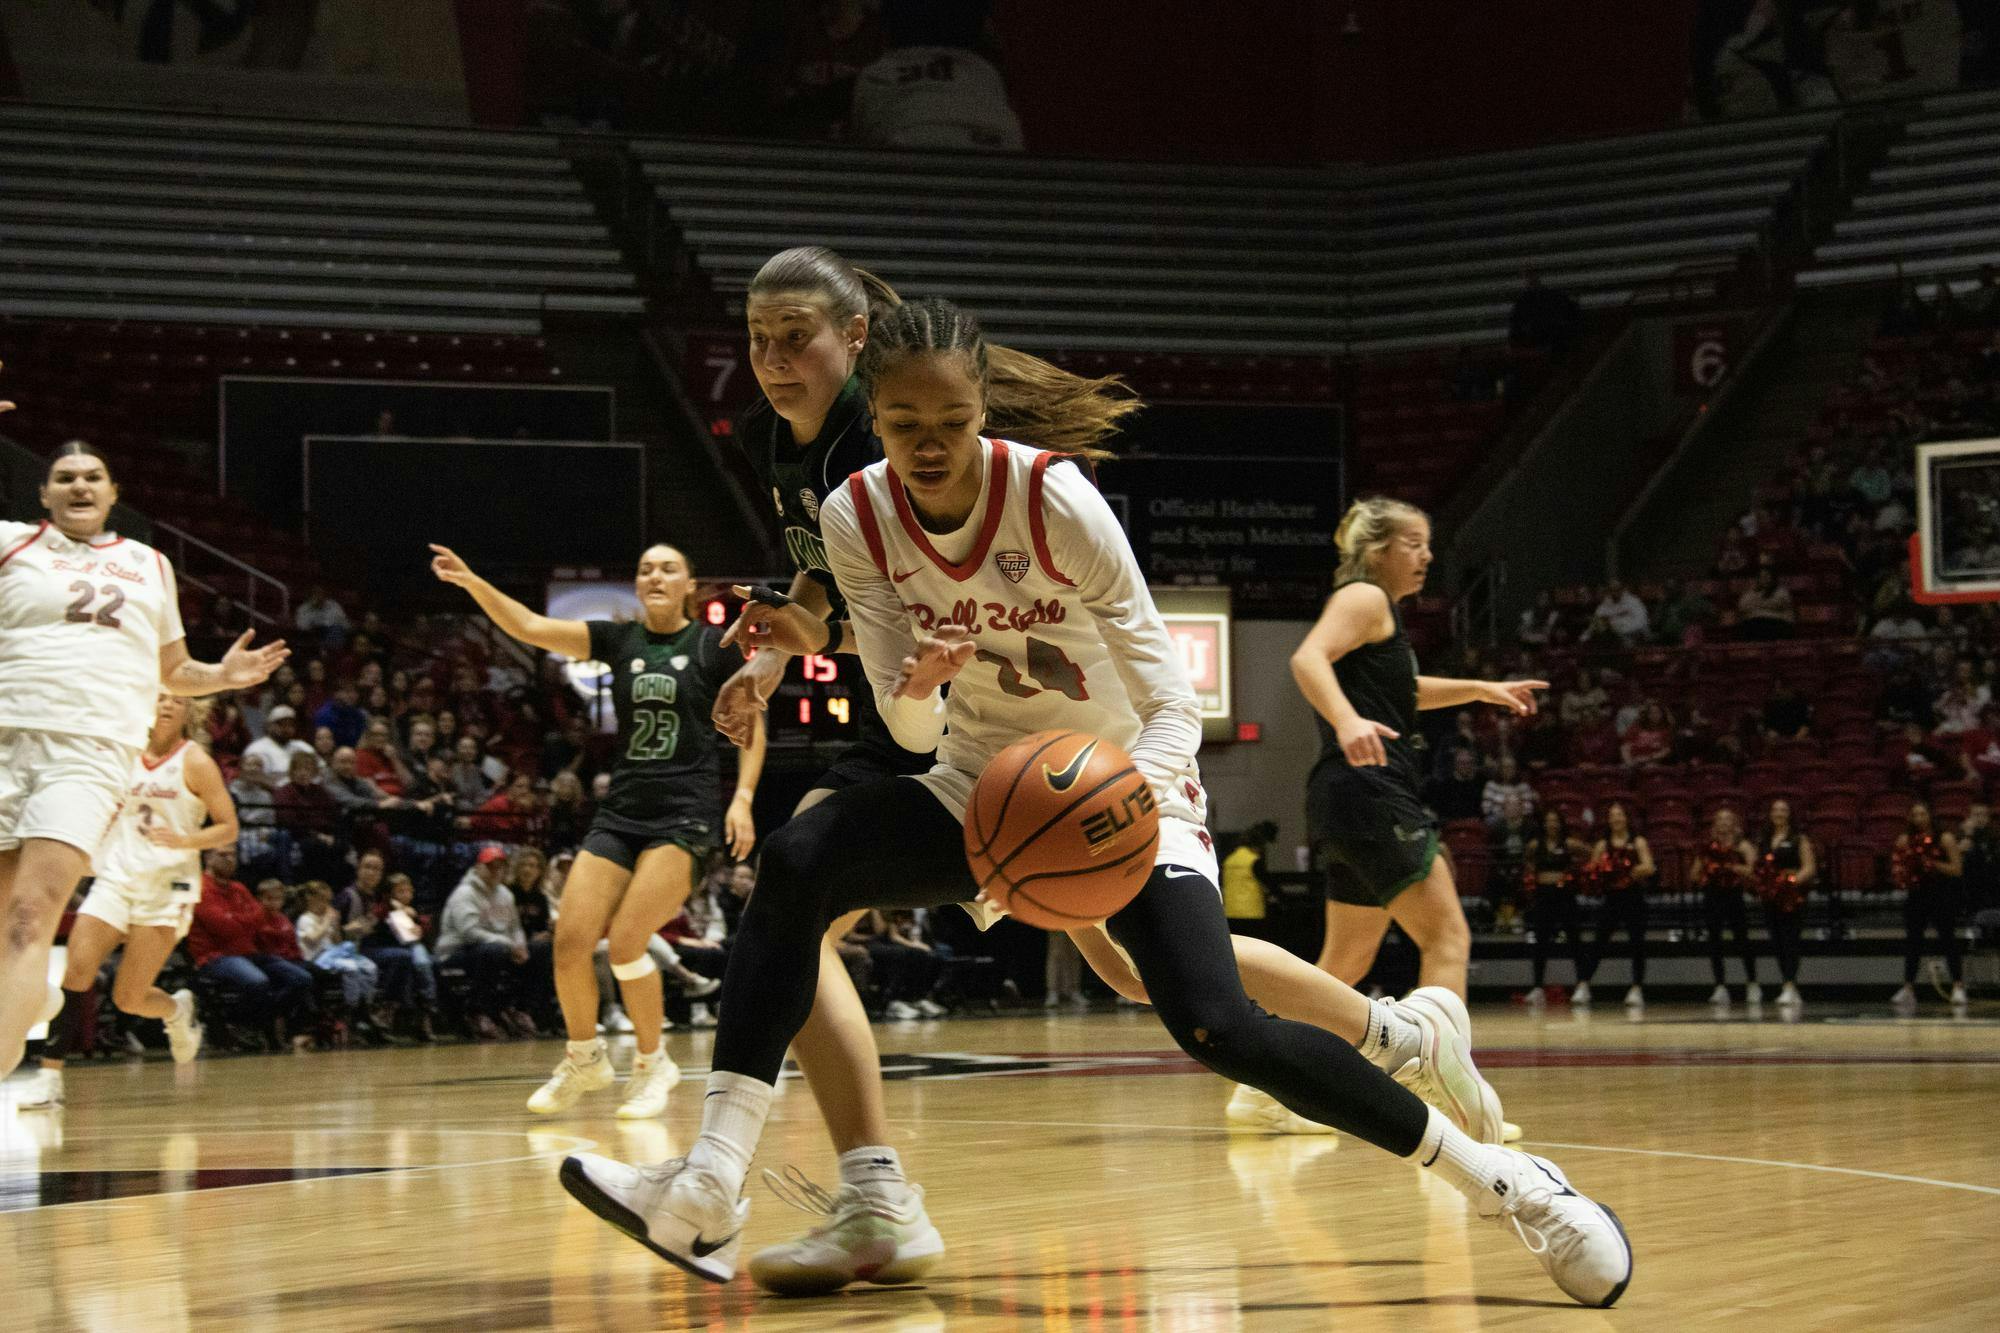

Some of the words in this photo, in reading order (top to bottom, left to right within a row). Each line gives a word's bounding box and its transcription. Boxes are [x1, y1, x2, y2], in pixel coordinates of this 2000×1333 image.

[704, 357, 738, 402] 7
[1691, 341, 1727, 387] 6
[1148, 498, 1216, 517] Official
[1220, 499, 1317, 518] Healthcare
[1150, 527, 1184, 545] and
[1187, 527, 1245, 549] Sports
[999, 561, 1030, 570] MAC
[65, 580, 125, 628] 22
[983, 598, 1066, 632] State
[803, 655, 838, 682] 15
[632, 673, 677, 704] OHIO
[798, 697, 812, 724] 1
[827, 697, 850, 724] 4
[626, 709, 680, 760] 23
[1080, 782, 1155, 846] ELITE
